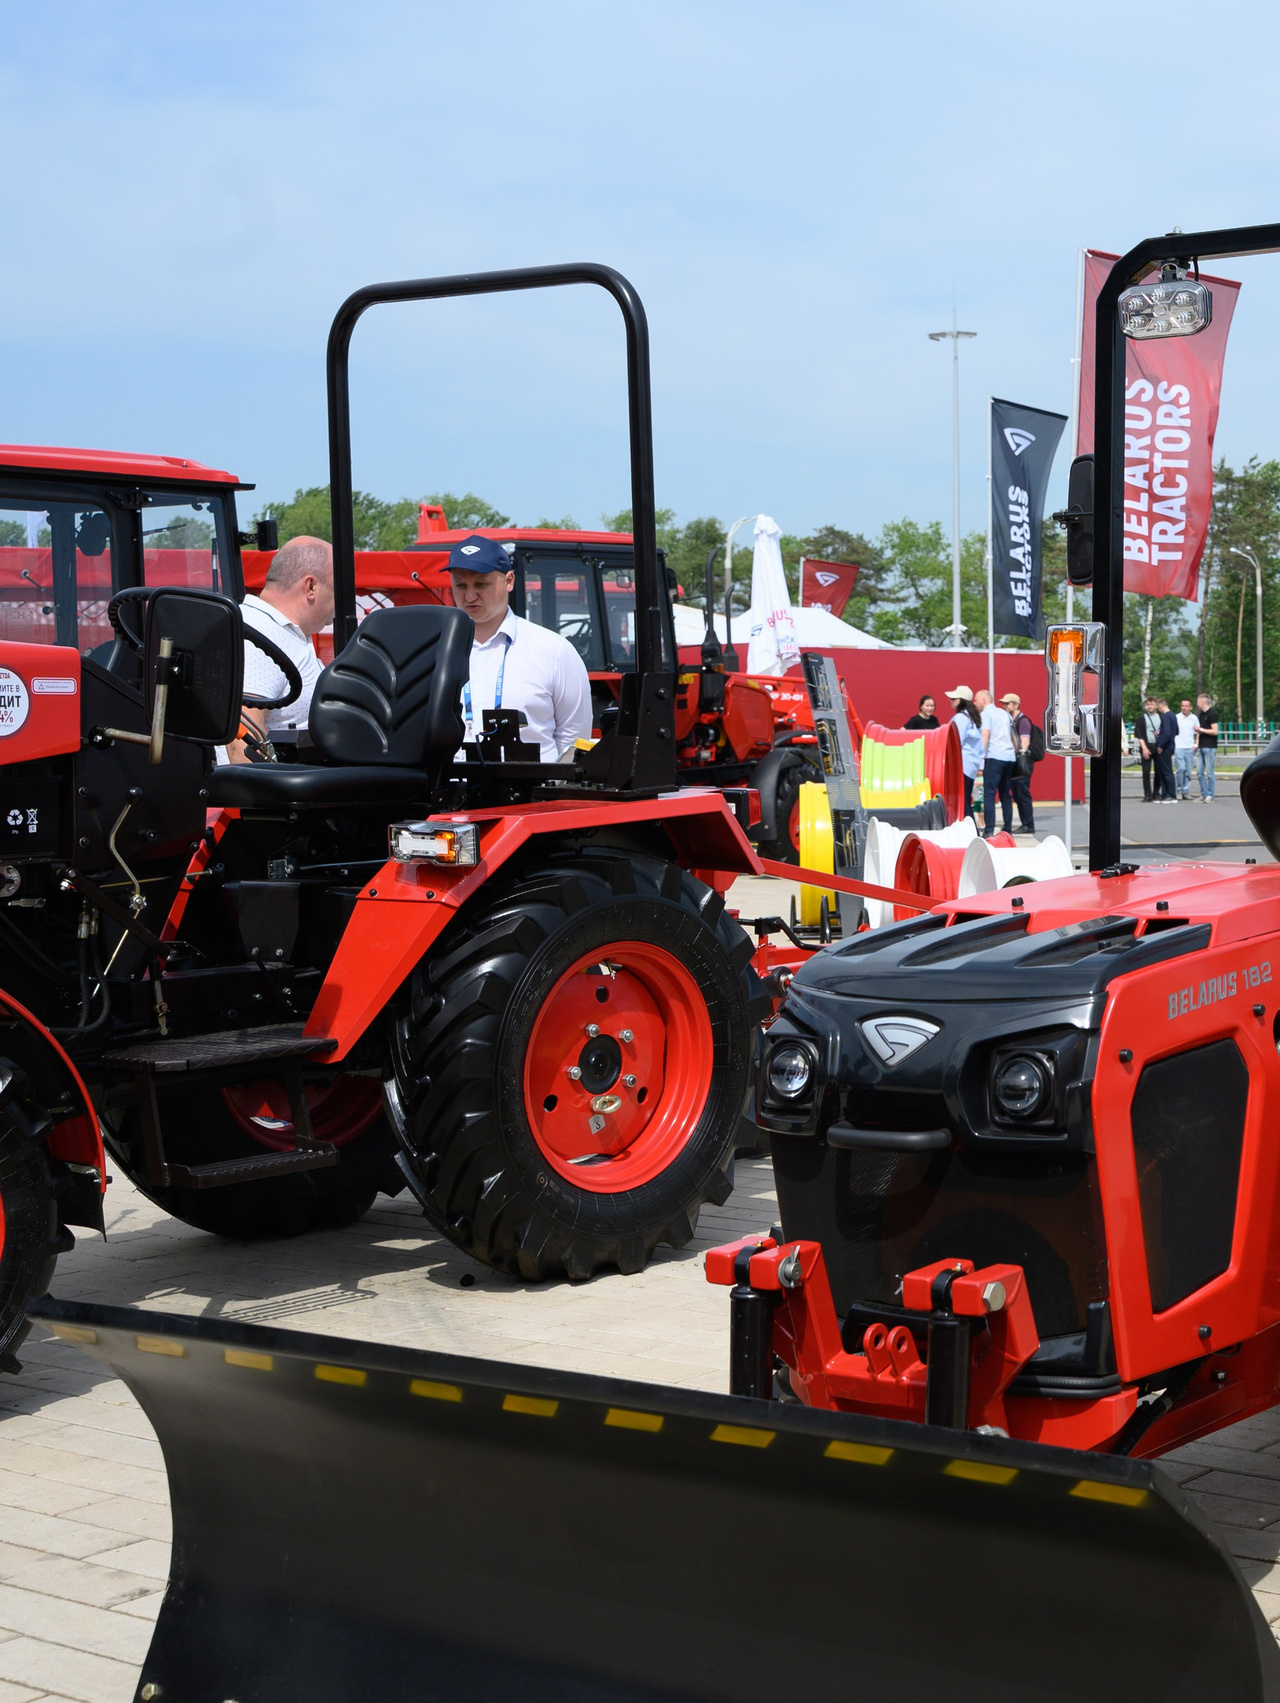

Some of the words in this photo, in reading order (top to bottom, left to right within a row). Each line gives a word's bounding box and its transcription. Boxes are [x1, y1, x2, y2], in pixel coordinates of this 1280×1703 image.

[1008, 484, 1030, 617] BELARUS
[1123, 378, 1155, 564] BELARUS
[1151, 381, 1192, 566] TRACTORS
[1167, 971, 1238, 1021] BELARUS
[1241, 960, 1273, 990] 182
